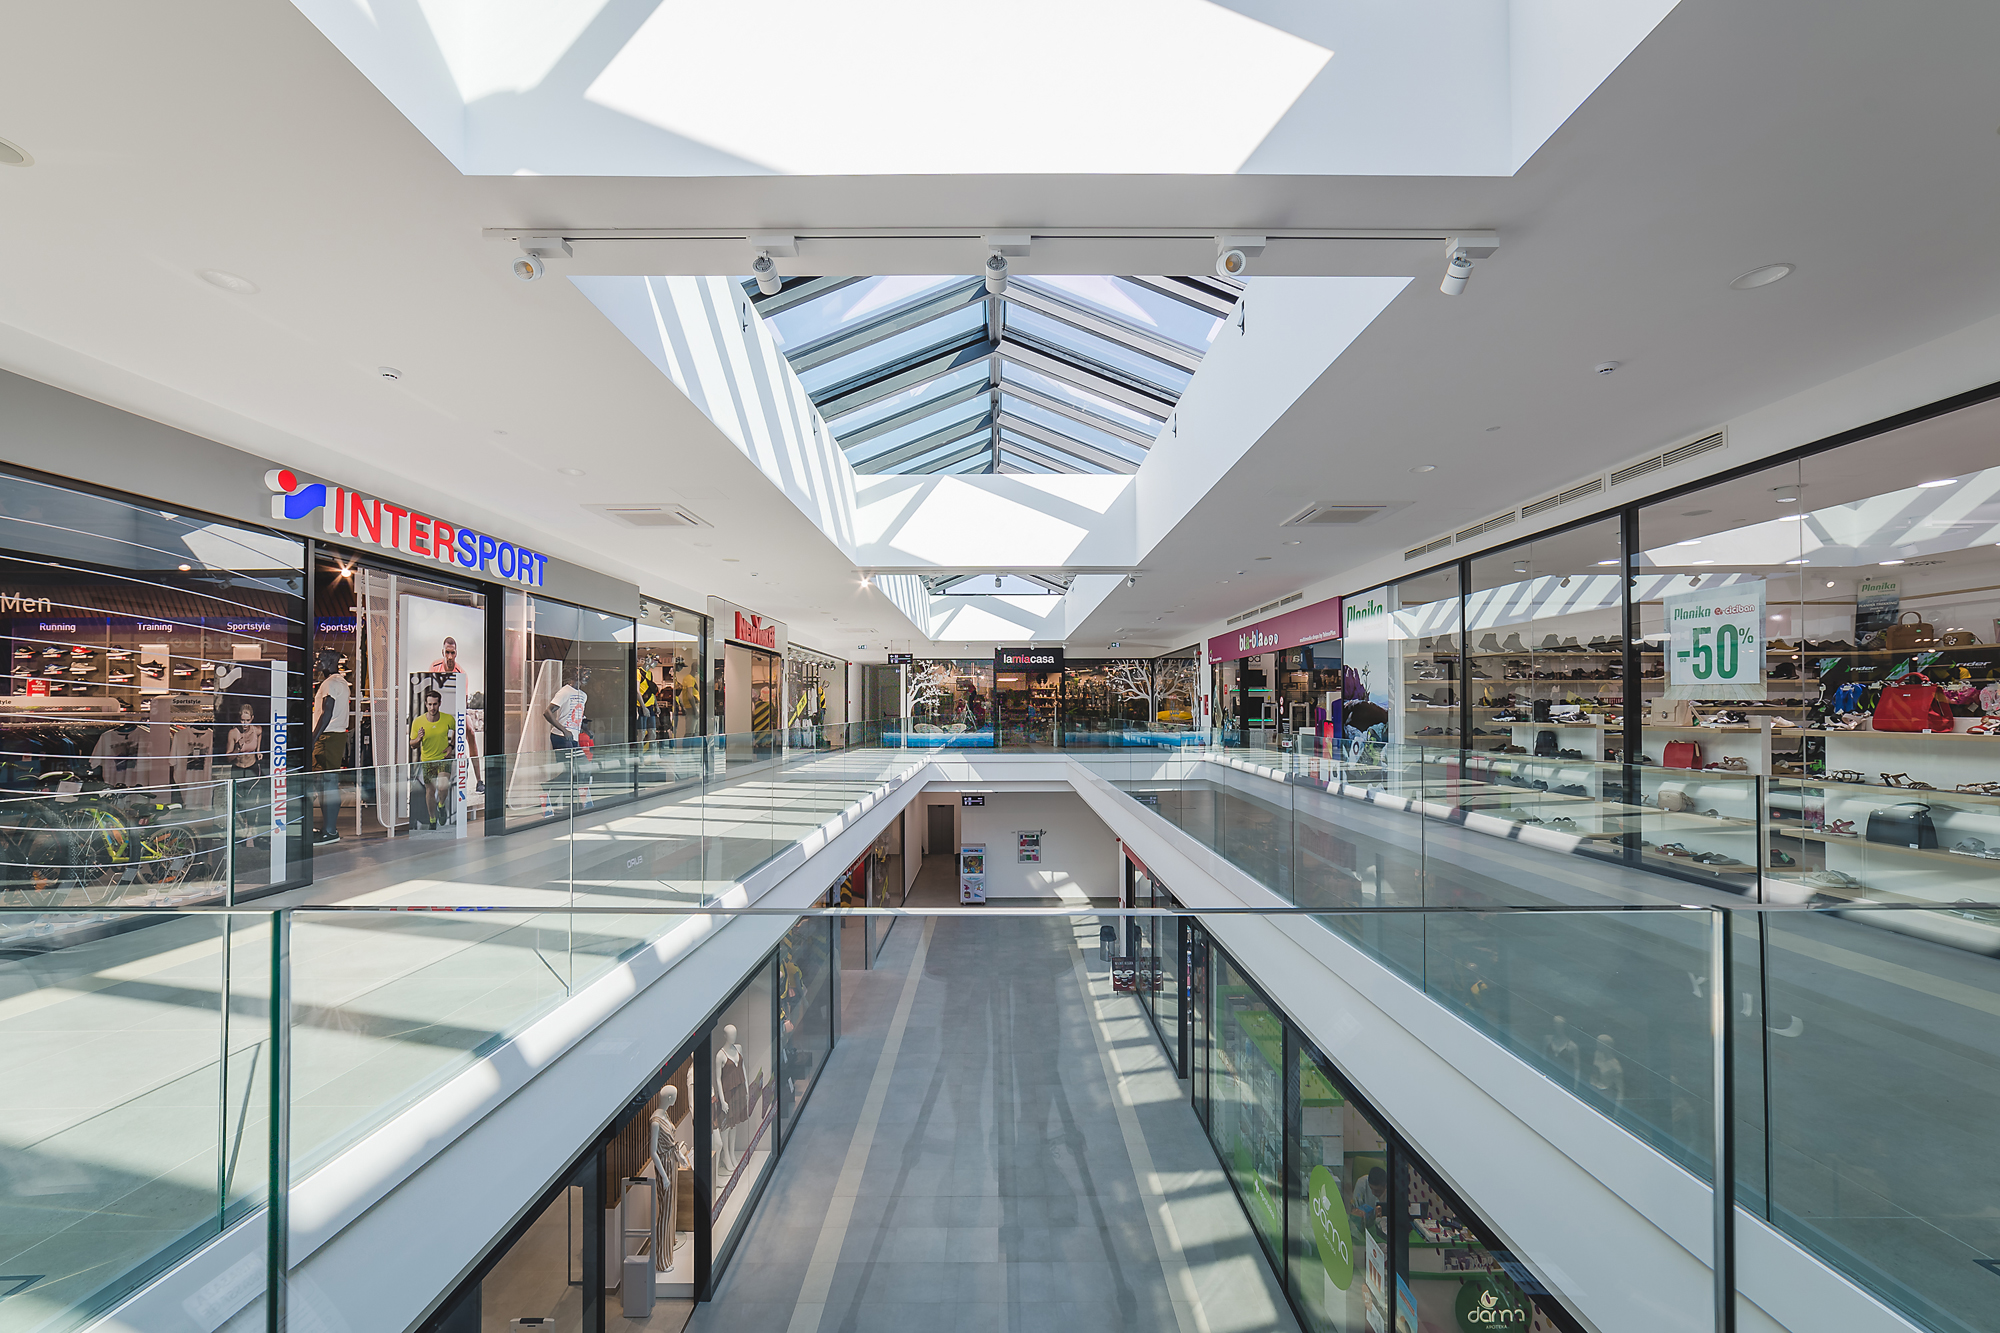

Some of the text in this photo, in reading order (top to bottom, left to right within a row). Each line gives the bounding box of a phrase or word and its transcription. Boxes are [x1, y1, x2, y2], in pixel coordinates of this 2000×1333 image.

[329, 486, 548, 587] INTERSPORT
[1861, 582, 1896, 592] Planika
[1, 591, 51, 613] Men
[1674, 606, 1711, 620] Planika
[39, 622, 76, 633] Running
[137, 622, 173, 633] Training
[226, 621, 271, 632] Sportstyle
[1239, 629, 1264, 651] bla-bla
[1003, 653, 1055, 664] lamiacasa
[457, 711, 466, 789] INTERSPORT
[274, 712, 288, 817] INTERSPORT
[1467, 1306, 1526, 1324] darma
